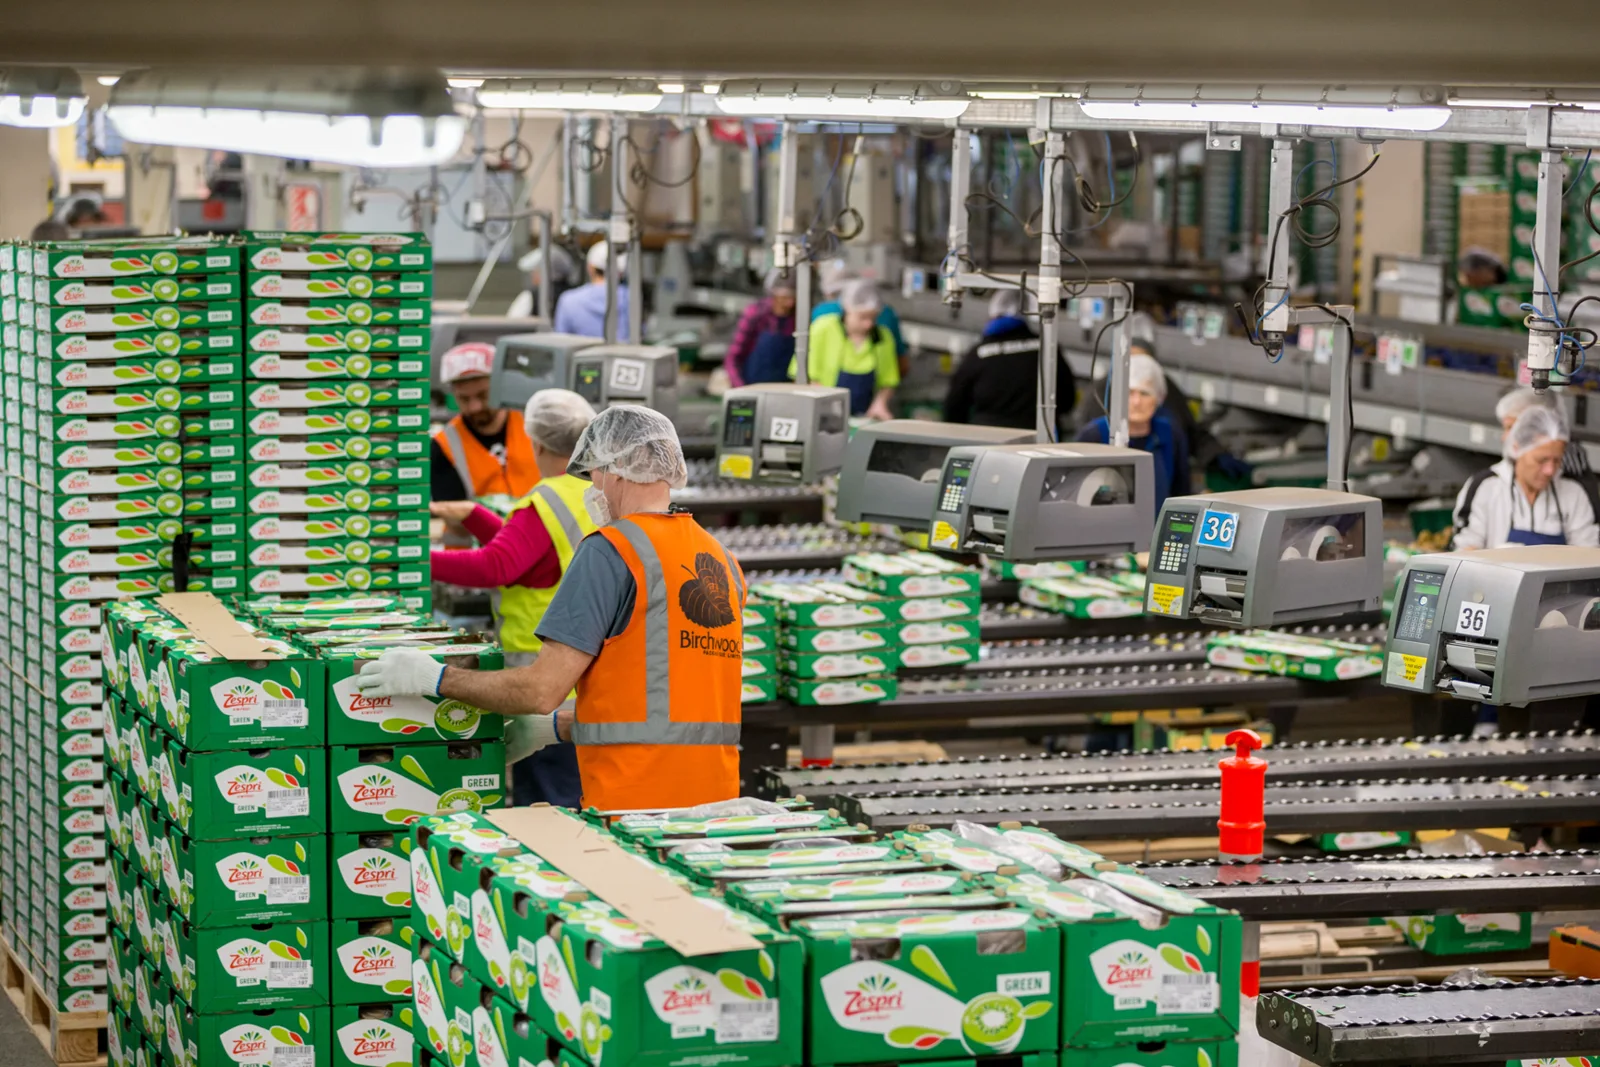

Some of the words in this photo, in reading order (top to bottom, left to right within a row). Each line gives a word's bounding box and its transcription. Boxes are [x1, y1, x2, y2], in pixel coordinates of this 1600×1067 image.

[774, 422, 792, 437] 27
[1204, 516, 1233, 542] 36
[1460, 608, 1485, 631] 36
[223, 693, 259, 708] Zespri
[350, 694, 392, 711] Zespri
[227, 781, 263, 796] Zespri
[468, 778, 494, 788] GREEN
[353, 784, 396, 802] Zespri
[228, 868, 264, 882] Zespri
[354, 867, 396, 885] Zespri
[230, 954, 265, 968] Zespri
[352, 956, 395, 974] Zespri
[1107, 964, 1154, 985] Zespri
[1004, 978, 1042, 992] GREEN
[663, 990, 712, 1012] Zespri
[844, 990, 903, 1017] Zespri
[232, 1040, 266, 1054] Zespri
[354, 1038, 396, 1056] Zespri
